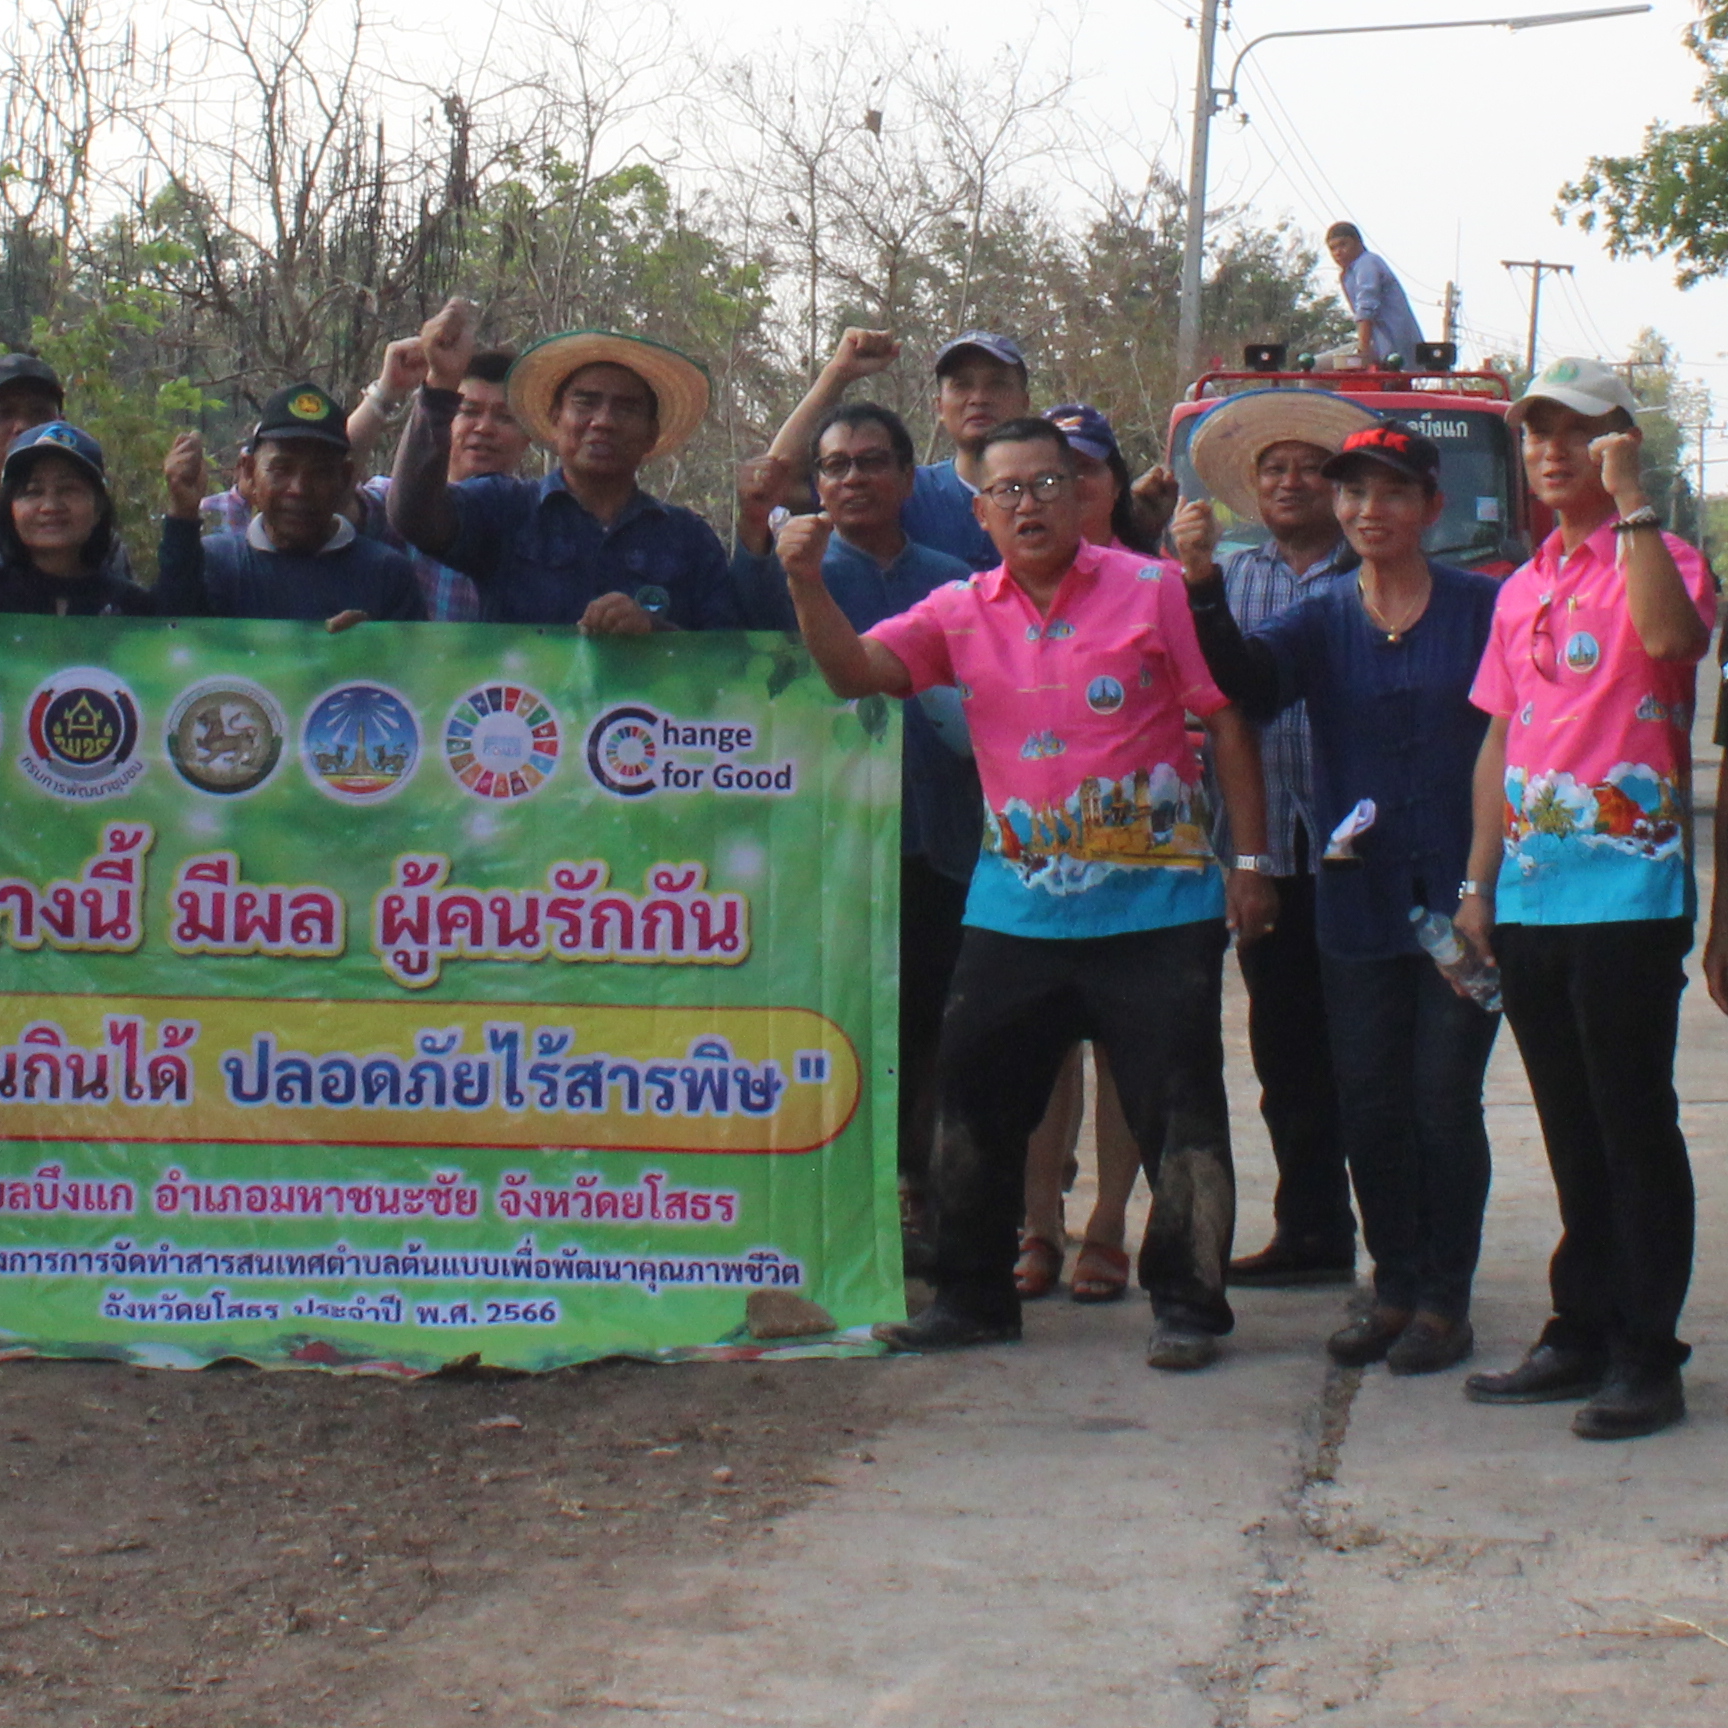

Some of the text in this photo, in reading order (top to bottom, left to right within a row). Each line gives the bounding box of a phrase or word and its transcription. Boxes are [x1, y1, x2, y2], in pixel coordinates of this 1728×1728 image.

[663, 761, 791, 790] for Good
[177, 860, 334, 944] มีผล
[382, 861, 739, 975] ผู้คนรักกัน
[156, 1170, 477, 1217] อำเภอมหาชนะชัย
[500, 1173, 735, 1222] จังหวัดยโสธร
[417, 1302, 477, 1324] พ.ศ.
[486, 1301, 557, 1323] 2566
